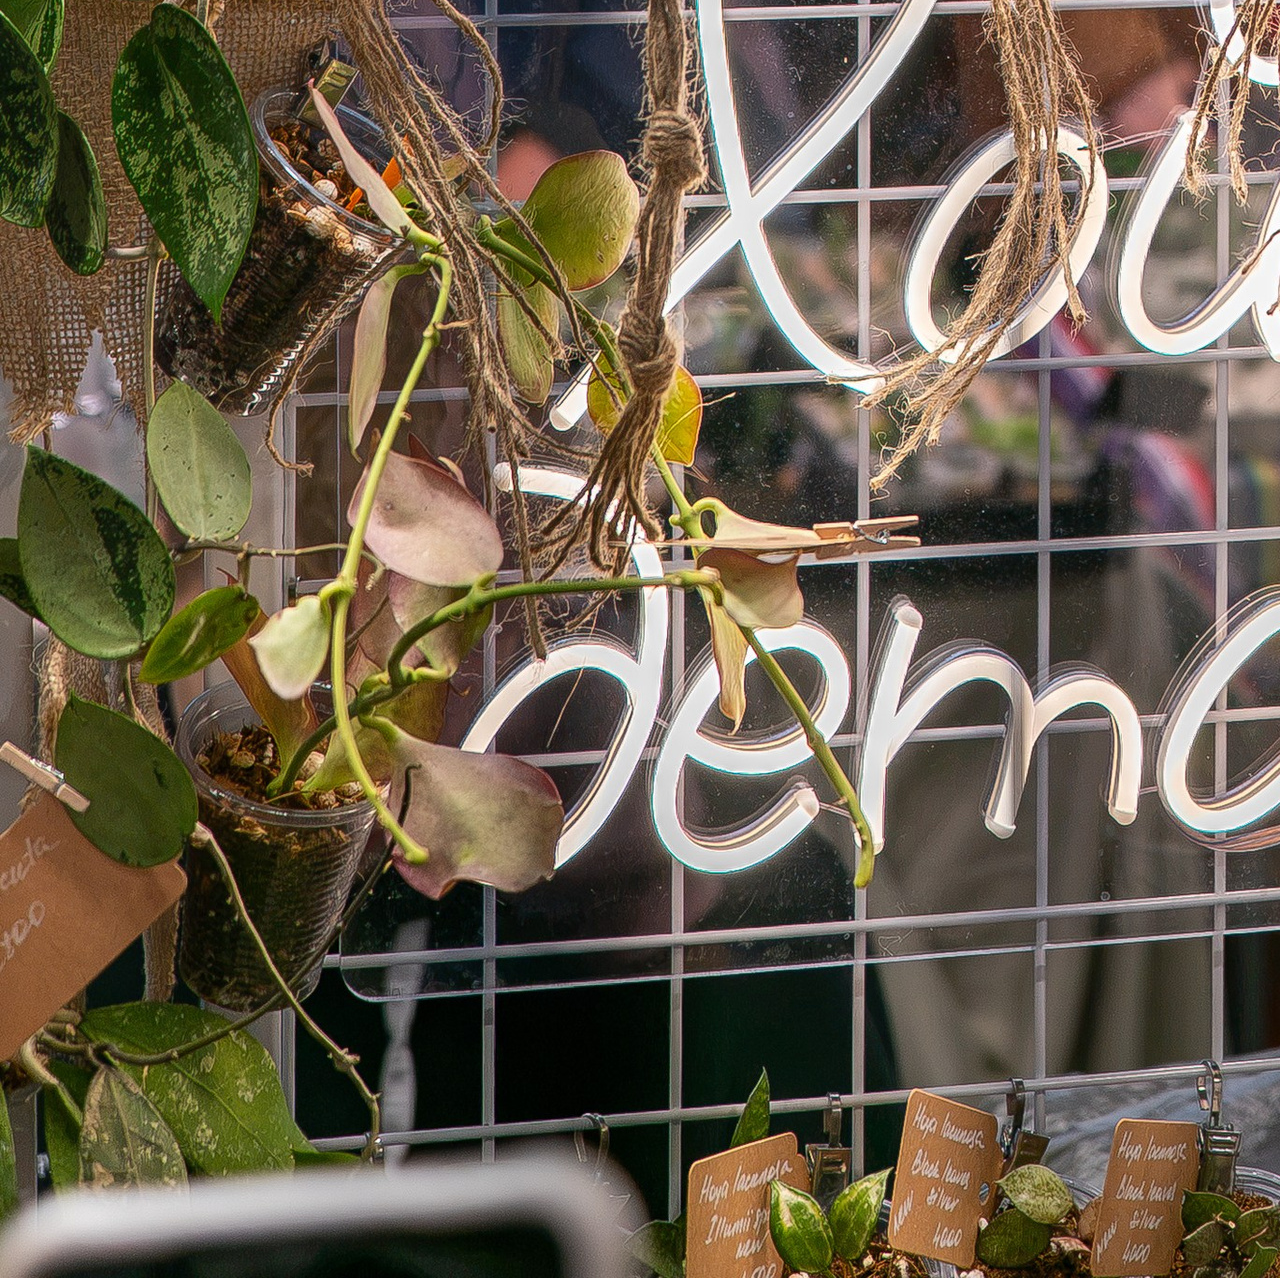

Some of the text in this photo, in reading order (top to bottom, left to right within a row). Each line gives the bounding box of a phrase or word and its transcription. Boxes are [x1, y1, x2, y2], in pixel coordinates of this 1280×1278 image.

[912, 1101, 938, 1140] Hoya
[1117, 1130, 1143, 1167] Hoya
[699, 1173, 730, 1211] Hoya
[933, 1221, 963, 1250] 4000
[1122, 1239, 1151, 1266] 4000
